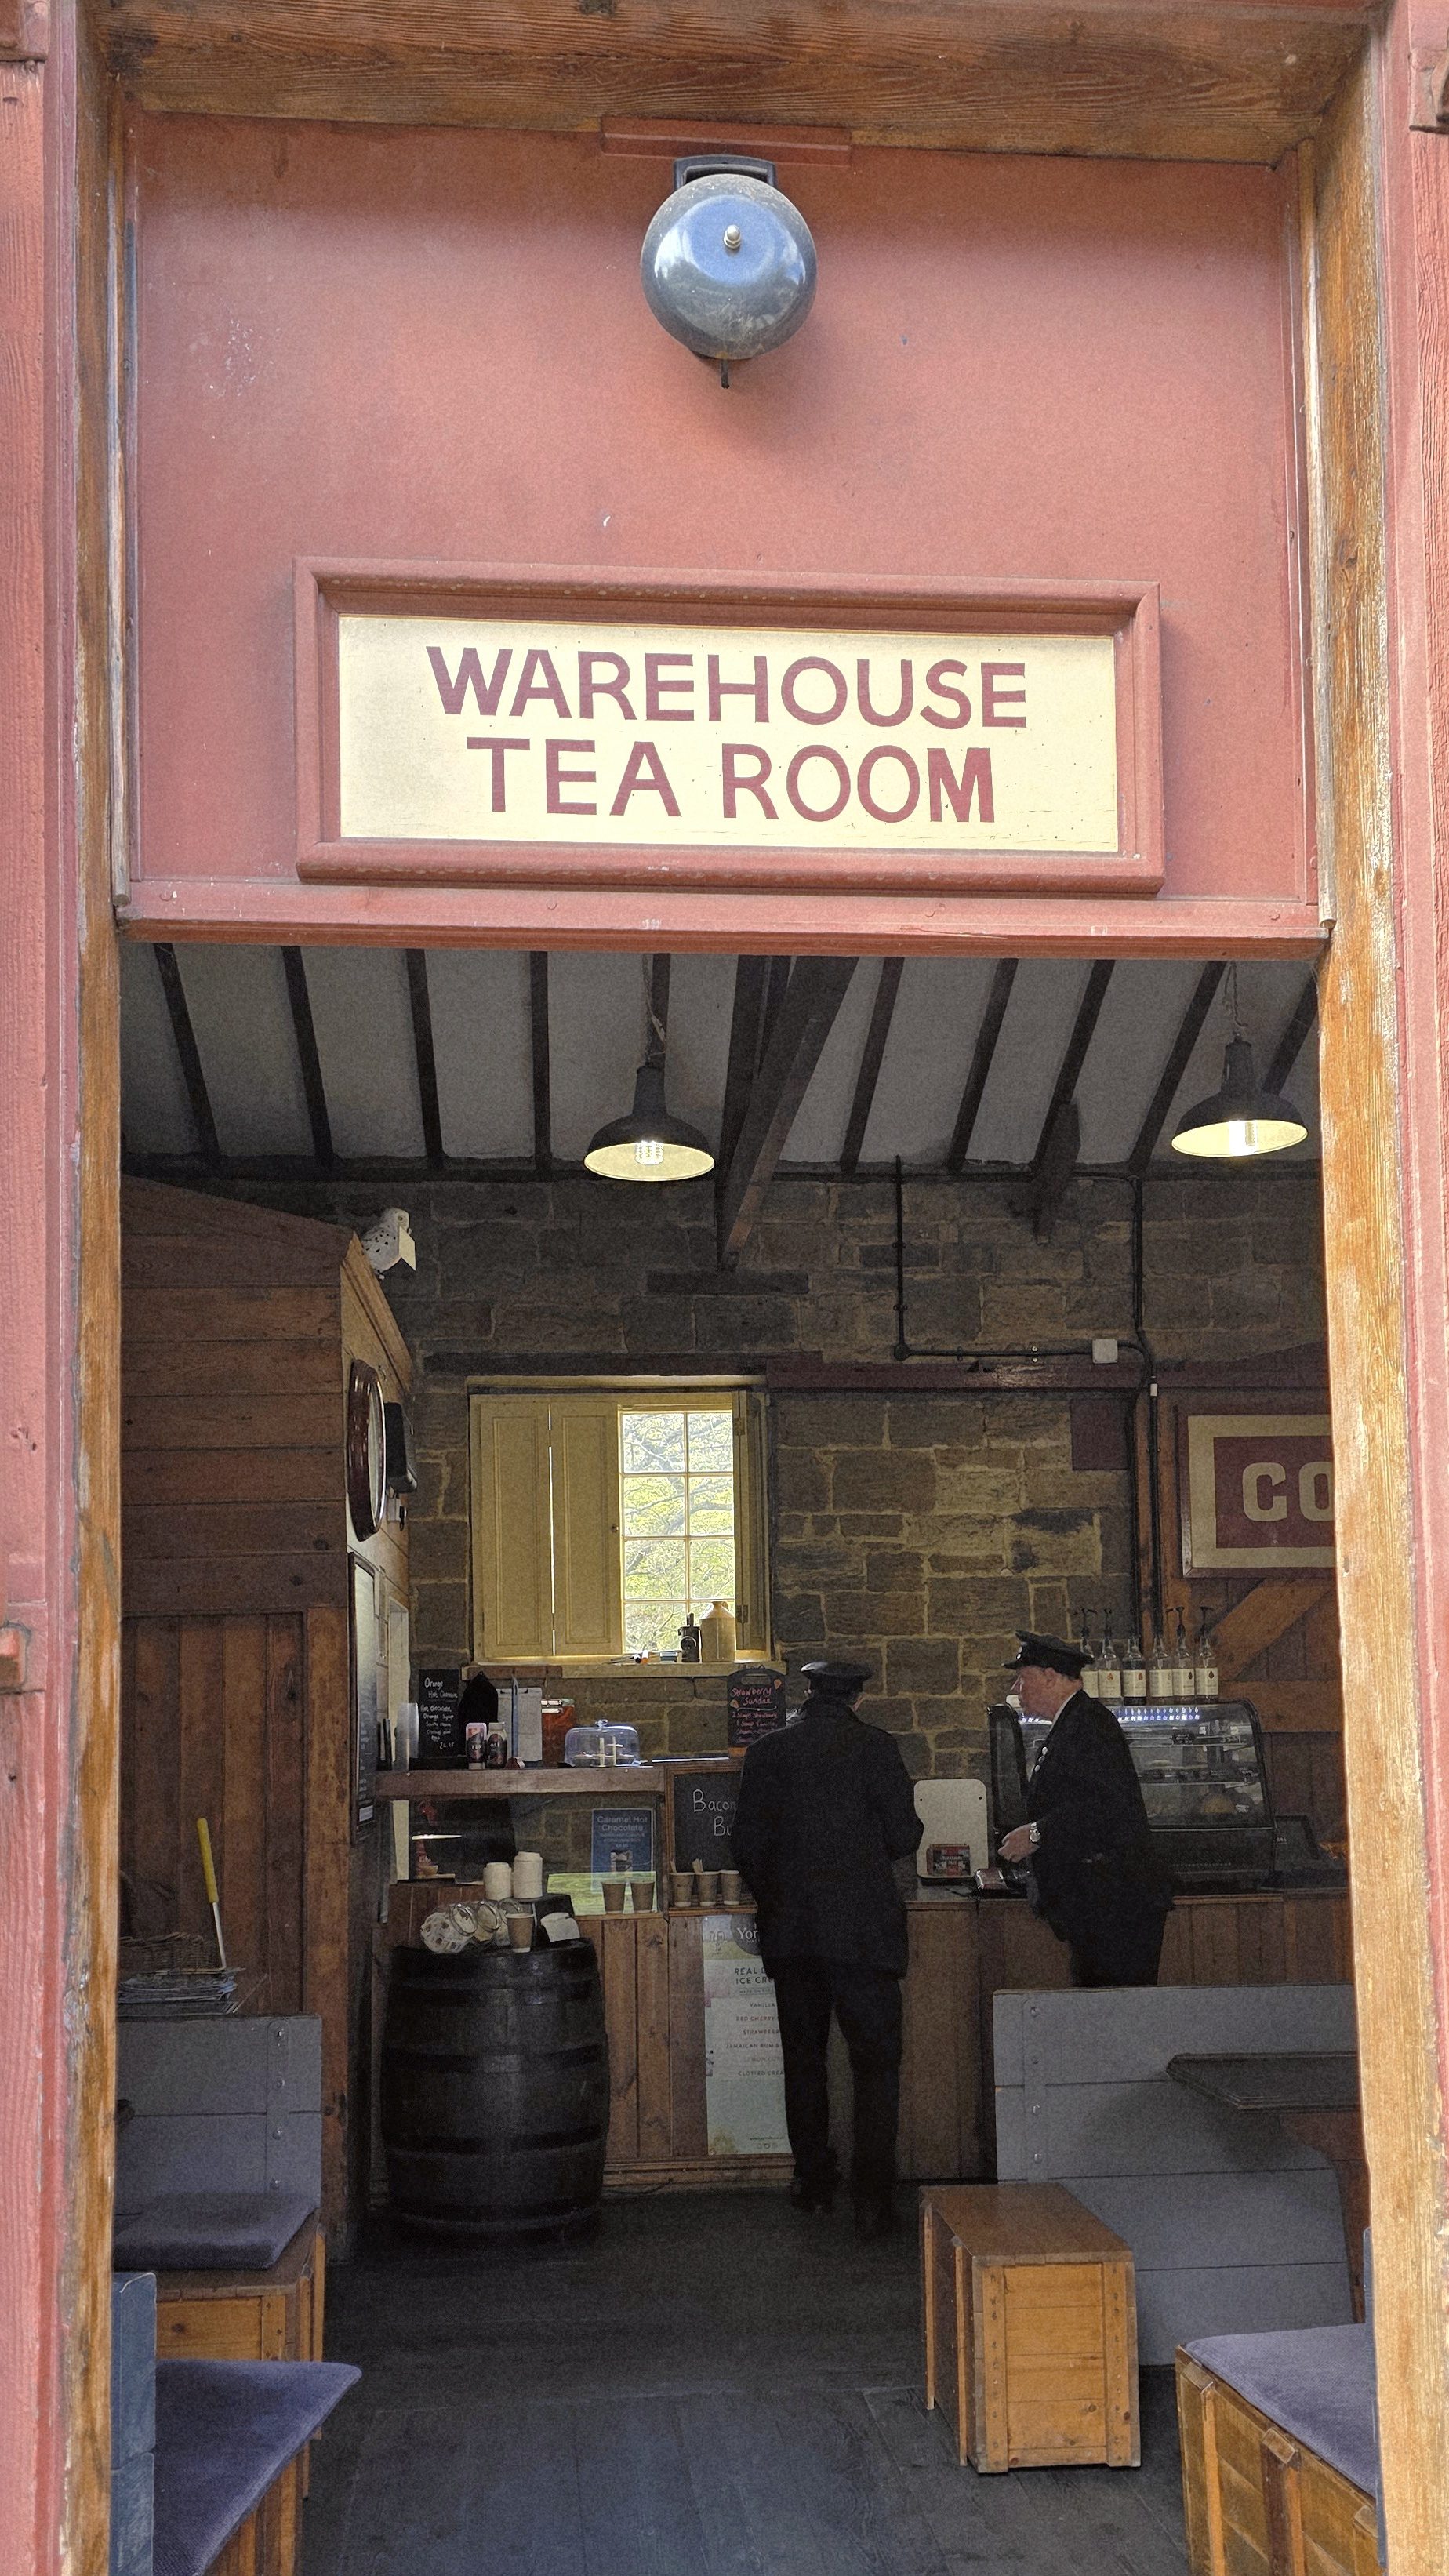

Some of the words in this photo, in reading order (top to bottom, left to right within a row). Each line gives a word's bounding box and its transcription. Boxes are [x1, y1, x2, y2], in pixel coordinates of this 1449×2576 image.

[426, 645, 1026, 729] WAREHOUSE
[466, 736, 682, 817] TEA
[721, 743, 995, 823] ROOM
[1242, 1461, 1335, 1522] CO
[424, 1677, 444, 1691] Orange
[731, 1687, 772, 1698] Strawberry
[742, 1696, 773, 1706] Sundae
[693, 1789, 737, 1812] Bacon
[601, 1823, 644, 1832] Chocolate
